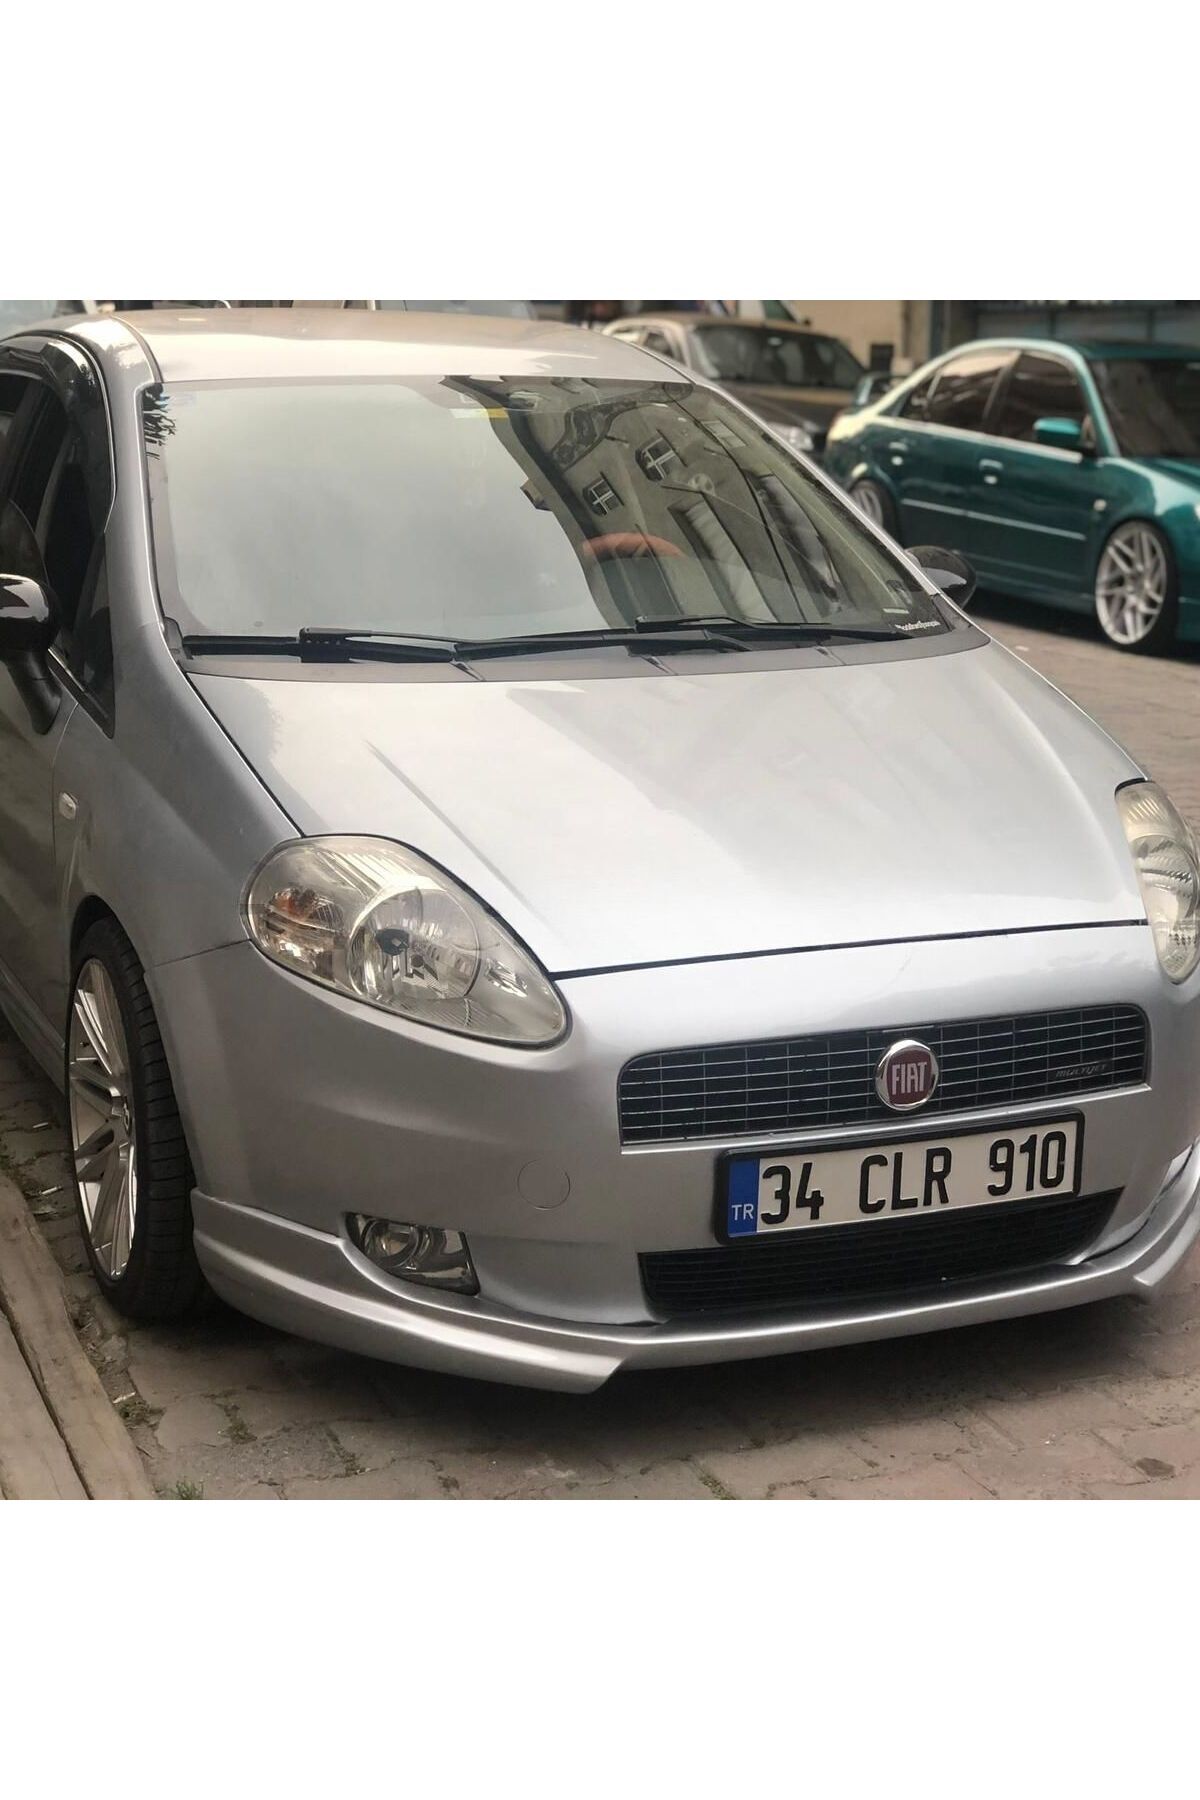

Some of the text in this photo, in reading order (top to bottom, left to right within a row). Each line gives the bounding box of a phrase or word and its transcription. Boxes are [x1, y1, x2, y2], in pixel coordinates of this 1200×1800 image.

[891, 1062, 928, 1096] FIAT
[760, 1131, 1066, 1225] 34 CLR 910
[731, 1203, 754, 1221] TR
